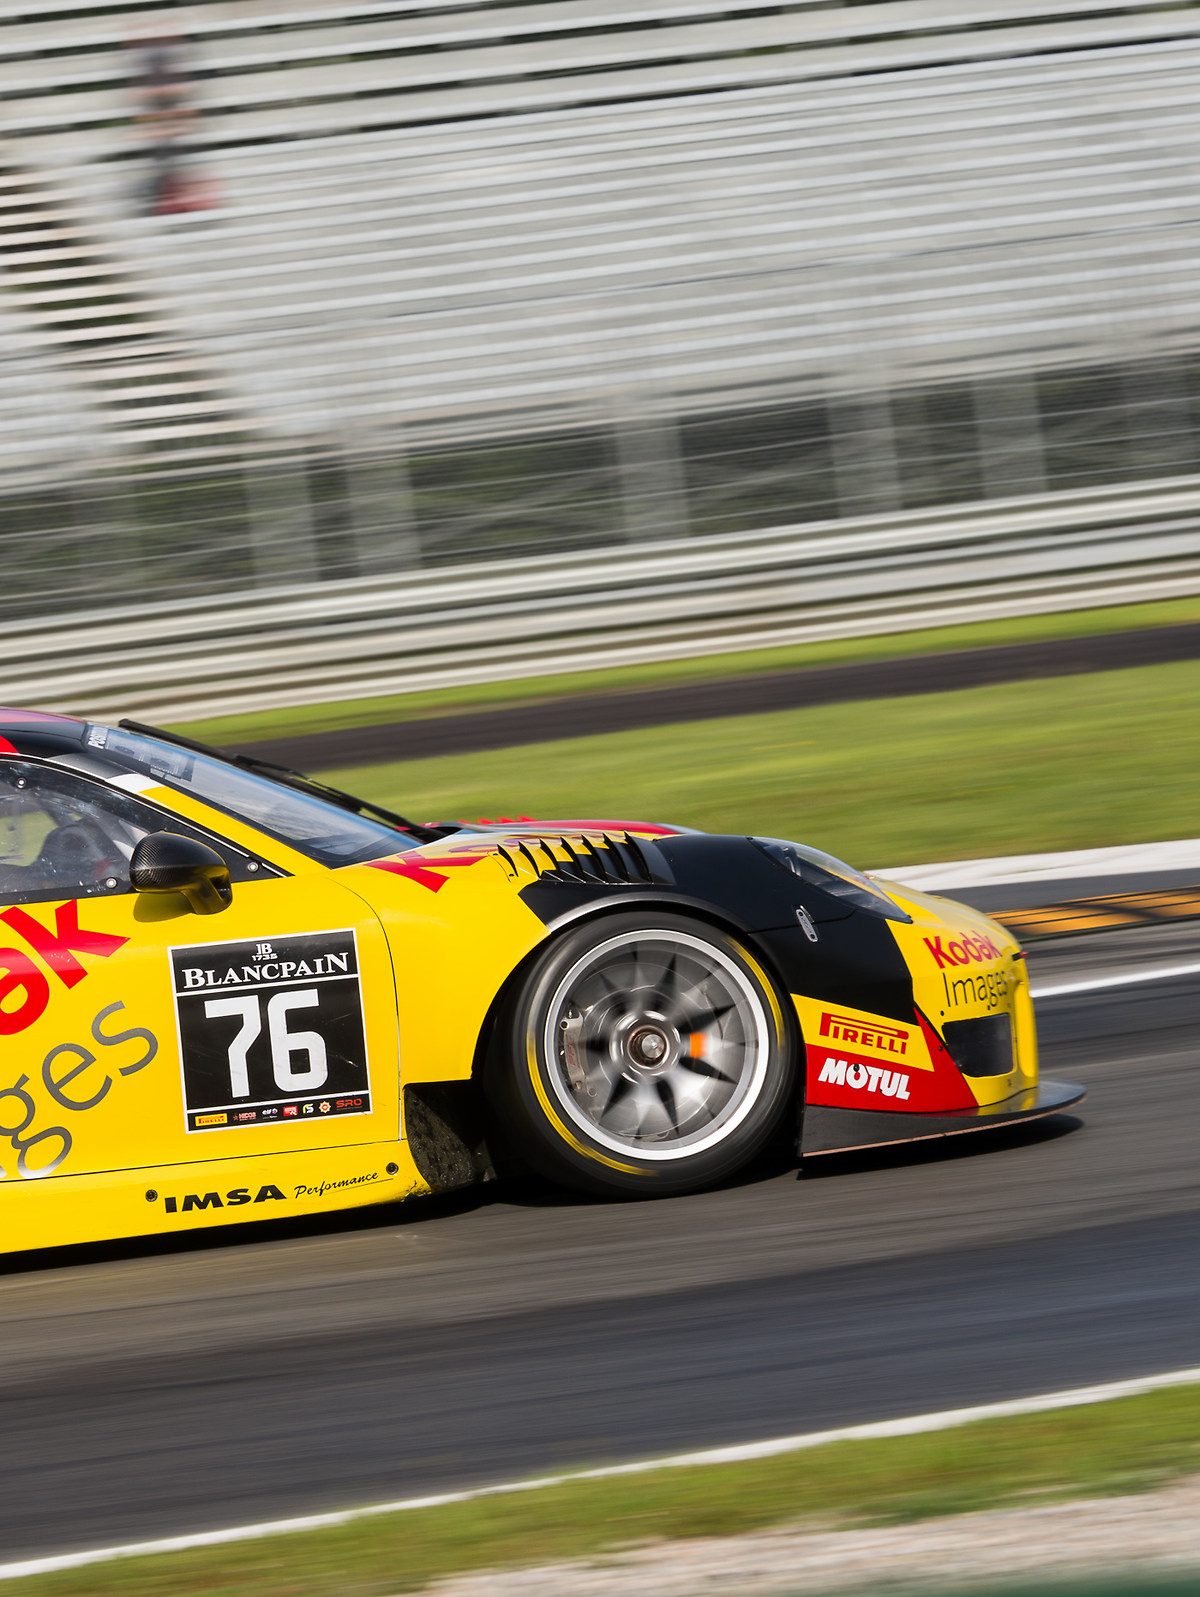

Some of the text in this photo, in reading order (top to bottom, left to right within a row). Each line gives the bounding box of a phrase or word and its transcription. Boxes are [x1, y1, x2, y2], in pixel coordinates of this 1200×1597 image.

[182, 952, 349, 989] BLANCPAIN
[922, 930, 1004, 969] Kodak
[942, 971, 1008, 1011] Images
[204, 988, 329, 1098] 76
[819, 1012, 909, 1055] PIRELLI
[818, 1058, 910, 1100] MOTUL
[164, 1171, 379, 1213] IMSA Performance
